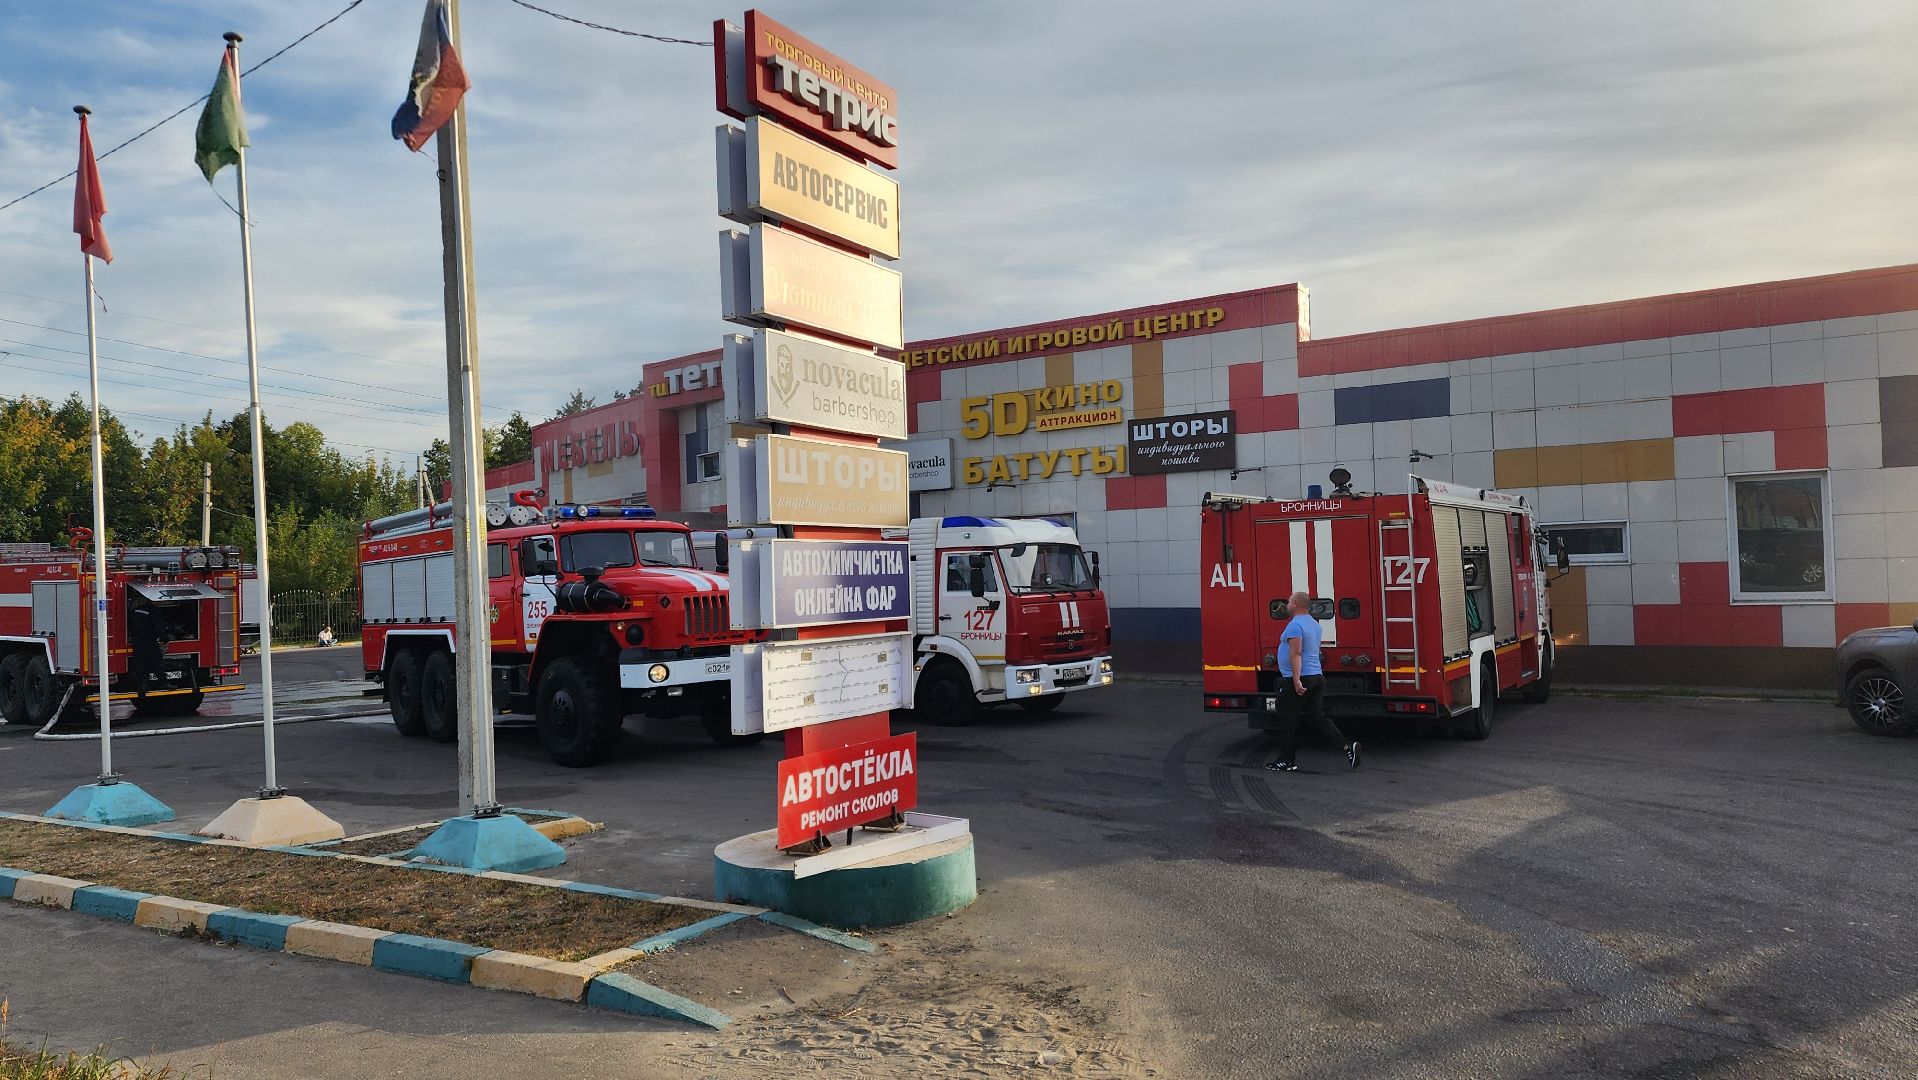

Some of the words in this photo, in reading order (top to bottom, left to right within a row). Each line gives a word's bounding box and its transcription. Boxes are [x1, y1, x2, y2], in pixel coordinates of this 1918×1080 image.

[773, 152, 888, 229] АВТОСЕРВИС
[898, 335, 1000, 371] ДЕТСКИЙ
[1007, 317, 1125, 354] ИГРОВОЙ
[1133, 307, 1226, 339] ЦЕНТР
[802, 357, 903, 403] novacula
[812, 390, 896, 428] barbershop
[959, 391, 1030, 441] 5D
[1033, 379, 1123, 411] КИНО
[1039, 410, 1118, 429] АТТРАКЦИОН
[1132, 416, 1229, 442] ШТОРЫ
[542, 420, 641, 473] МЕБЕЛЬ
[1137, 440, 1226, 458] индивидуального
[1160, 452, 1201, 466] пошива
[776, 446, 902, 493] ШТОРЫ
[908, 455, 946, 470] vacula
[961, 444, 1127, 485] БАТУТЫ
[782, 549, 904, 577] АВТОХИМЧИСТКА
[1209, 562, 1245, 592] АЦ
[1384, 557, 1431, 585] 127
[527, 600, 548, 619] 255
[794, 584, 863, 616] ОКЛЕЙКА
[865, 585, 897, 611] ФАР
[963, 610, 996, 631] 127
[960, 632, 1003, 642] БРОННИЦЫ
[782, 748, 914, 807] АВТОСТЁКЛА
[800, 801, 850, 830] РЕМОНТ
[852, 788, 899, 815] СКОЛОВ
